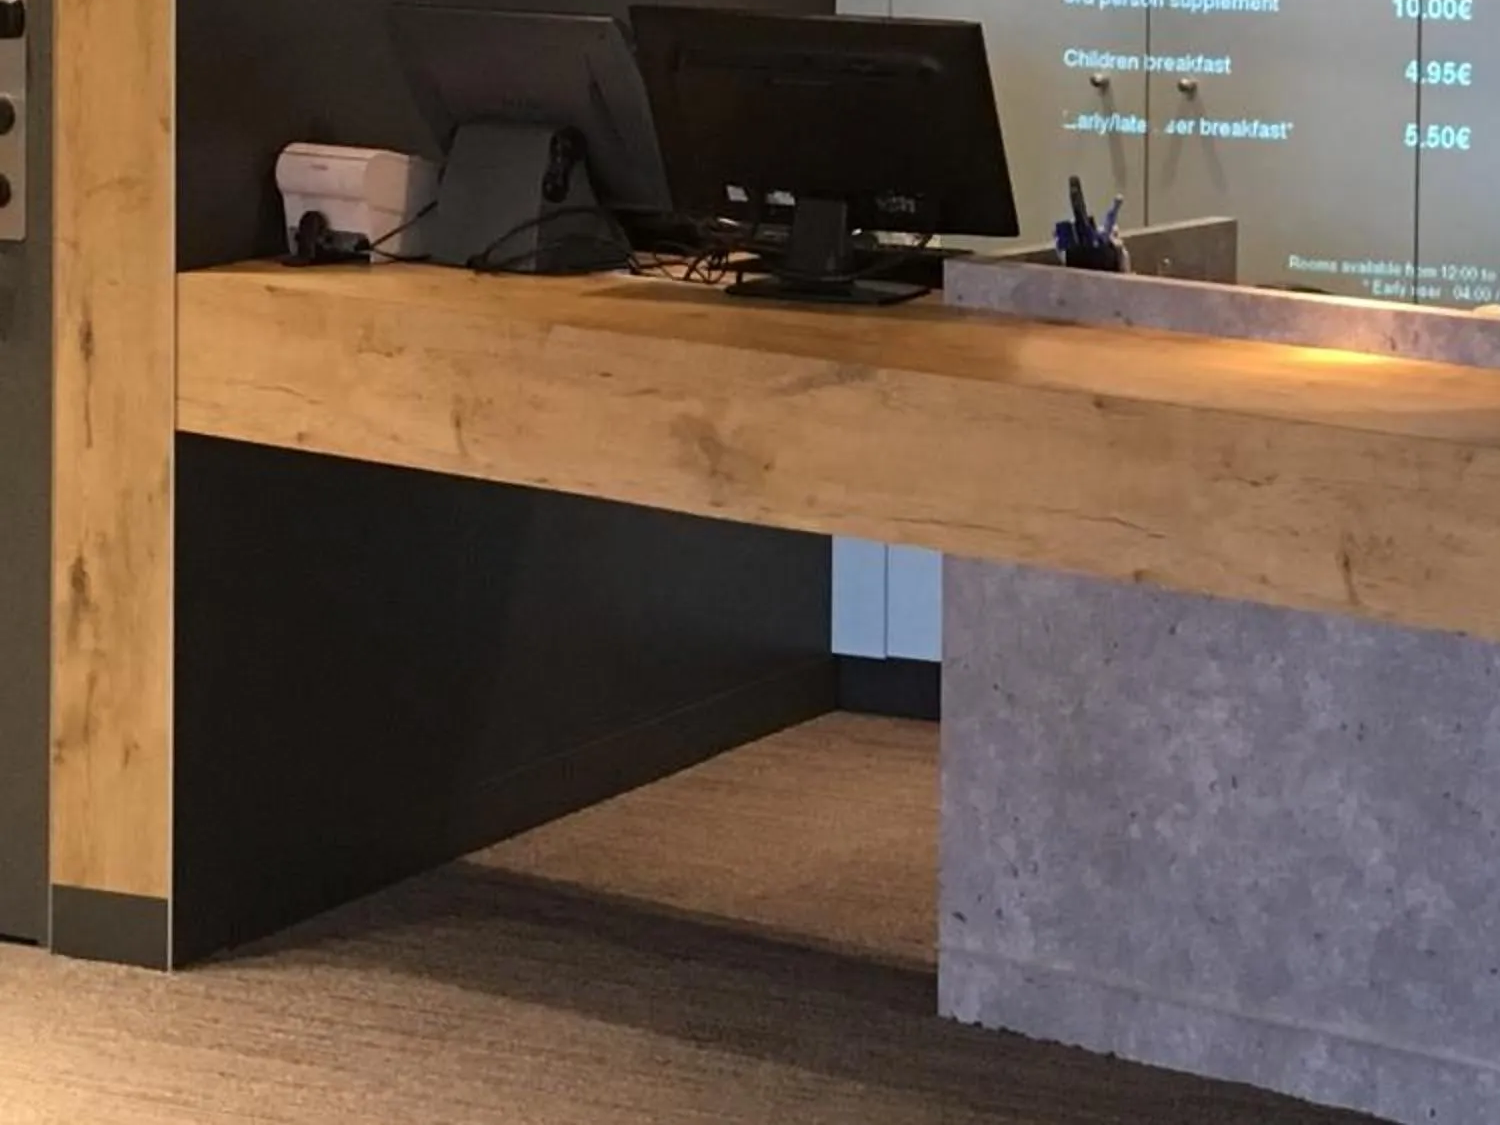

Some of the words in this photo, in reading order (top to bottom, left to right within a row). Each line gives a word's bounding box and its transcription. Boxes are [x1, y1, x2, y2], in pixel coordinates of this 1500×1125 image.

[1063, 48, 1139, 71] Children
[1143, 54, 1232, 75] breakfast
[1405, 59, 1473, 86] 4.95€
[1063, 109, 1147, 135] arly/late
[1403, 122, 1472, 151] 5.50€
